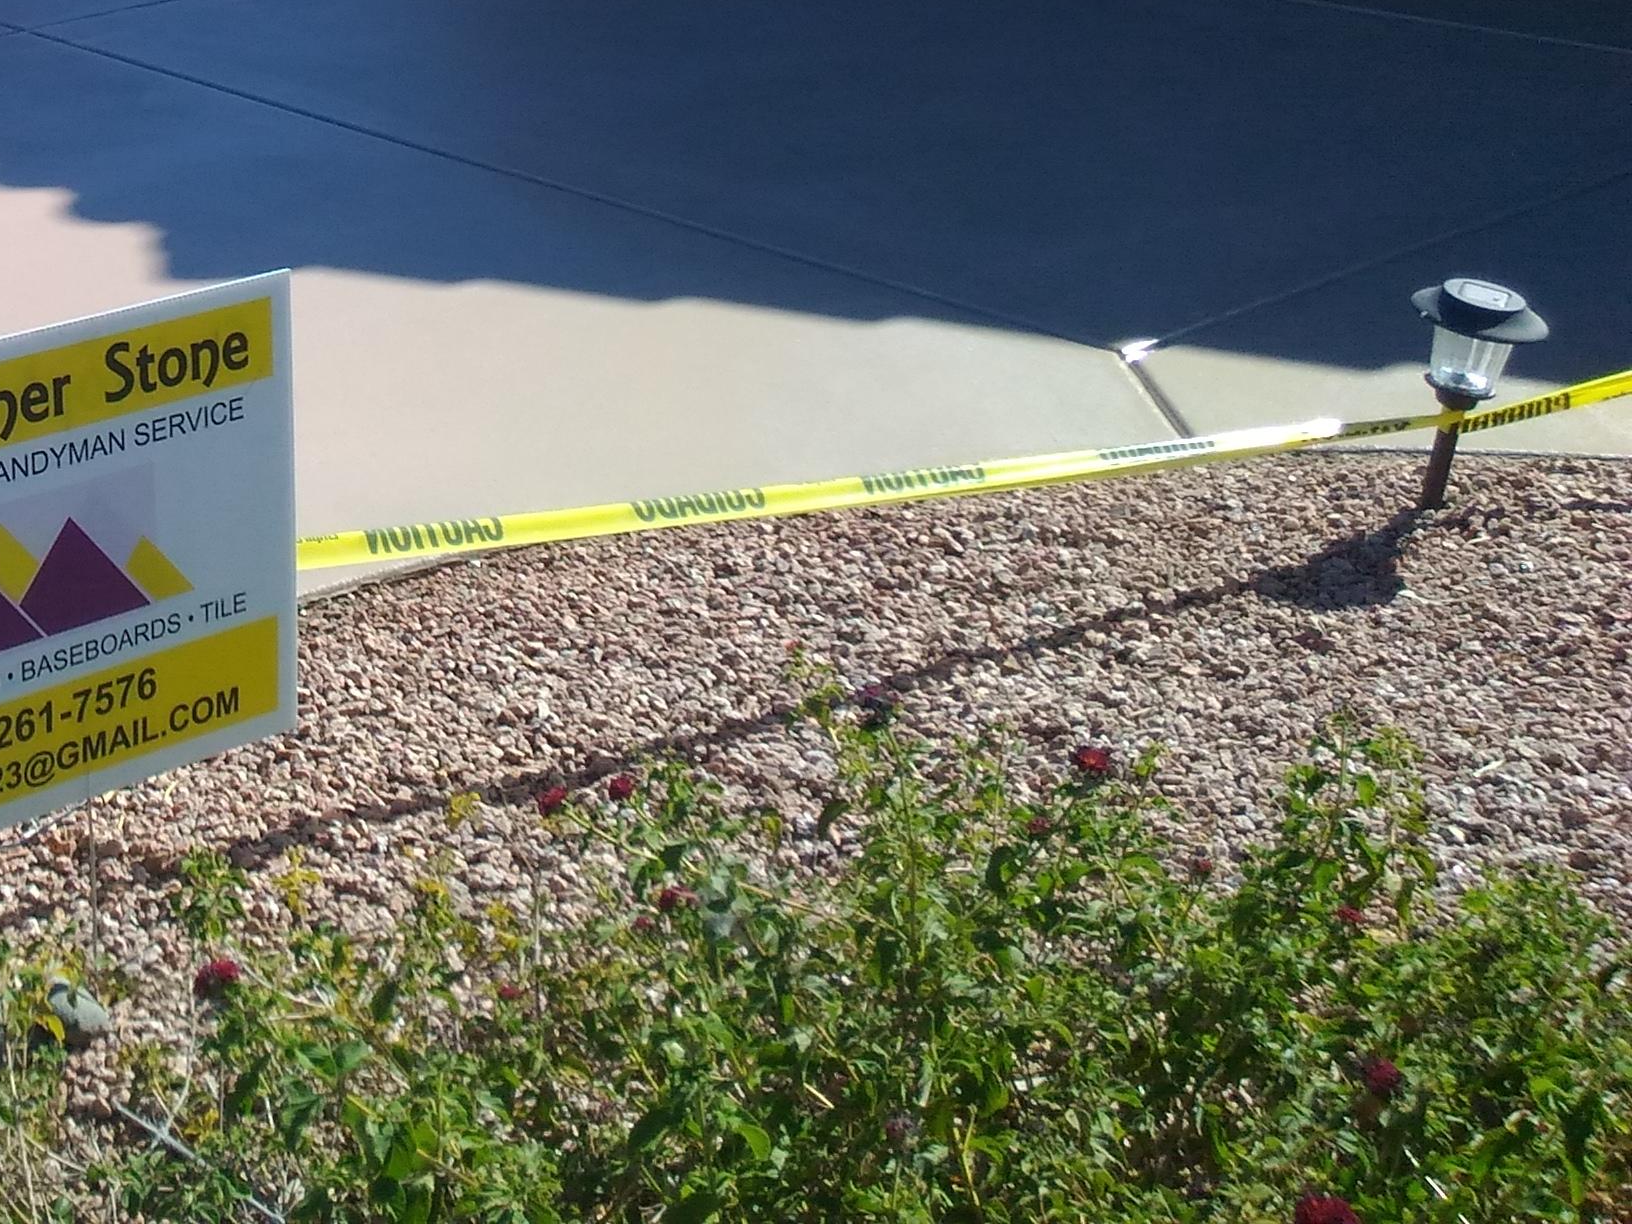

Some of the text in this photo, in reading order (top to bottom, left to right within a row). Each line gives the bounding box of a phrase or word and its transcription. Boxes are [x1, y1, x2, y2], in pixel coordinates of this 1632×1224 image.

[105, 331, 249, 403] Stone
[134, 397, 245, 446] SERVICE
[21, 613, 182, 681] BASEBOARDS
[200, 592, 248, 624] TILE
